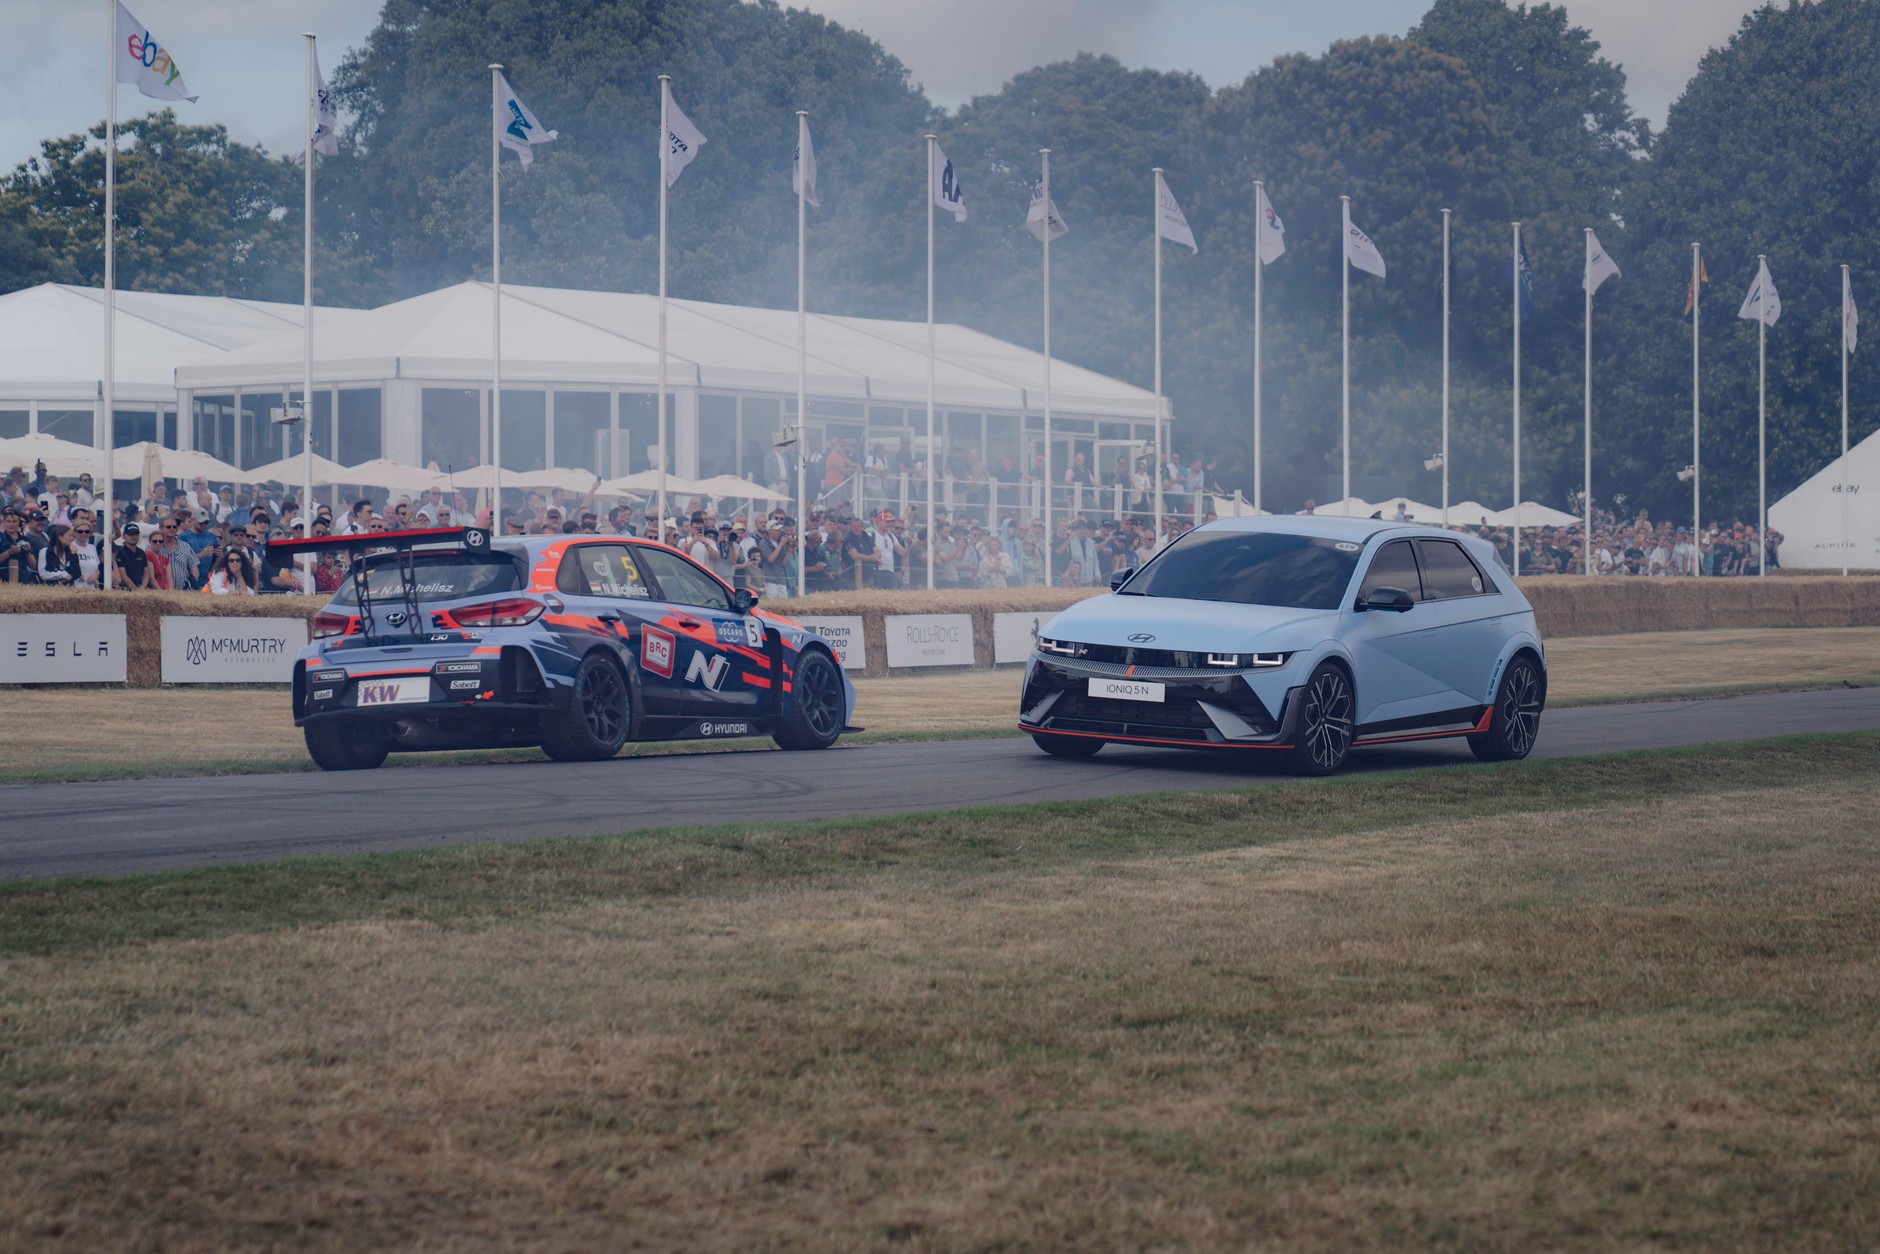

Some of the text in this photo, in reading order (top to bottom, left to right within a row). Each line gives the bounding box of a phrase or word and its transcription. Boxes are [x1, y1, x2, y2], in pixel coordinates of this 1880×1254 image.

[128, 31, 180, 86] ebay
[620, 556, 638, 581] 5
[749, 624, 758, 643] 5
[819, 626, 851, 637] TOYOTA
[906, 625, 959, 644] ROLLS-ROYCE
[649, 641, 667, 658] BRC
[827, 639, 848, 648] ZOO
[362, 684, 400, 703] KW
[1106, 684, 1149, 695] IONIQ 5 N
[714, 723, 748, 733] HYUNDAI
